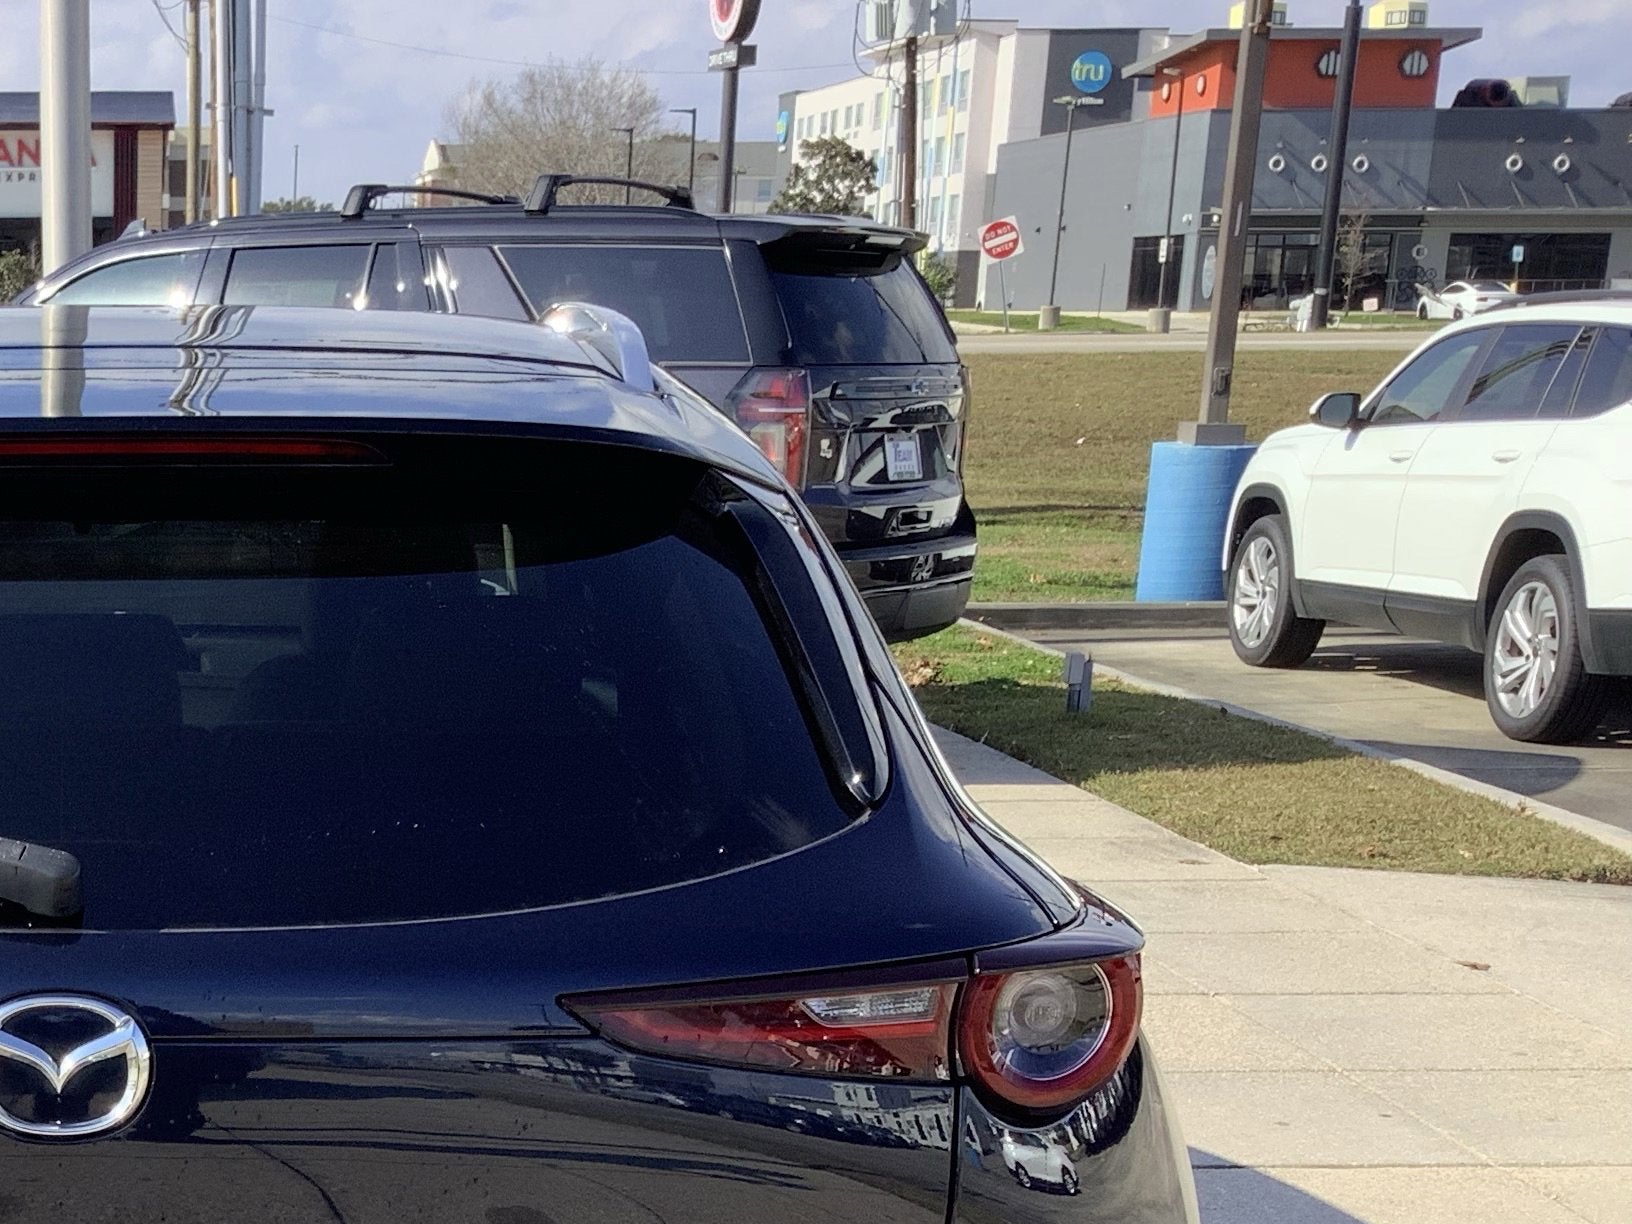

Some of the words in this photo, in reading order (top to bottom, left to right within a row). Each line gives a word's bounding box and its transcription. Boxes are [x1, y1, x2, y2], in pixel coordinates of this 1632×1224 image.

[985, 231, 996, 240] DO
[997, 225, 1011, 235] NOT
[992, 241, 1014, 255] ENTER
